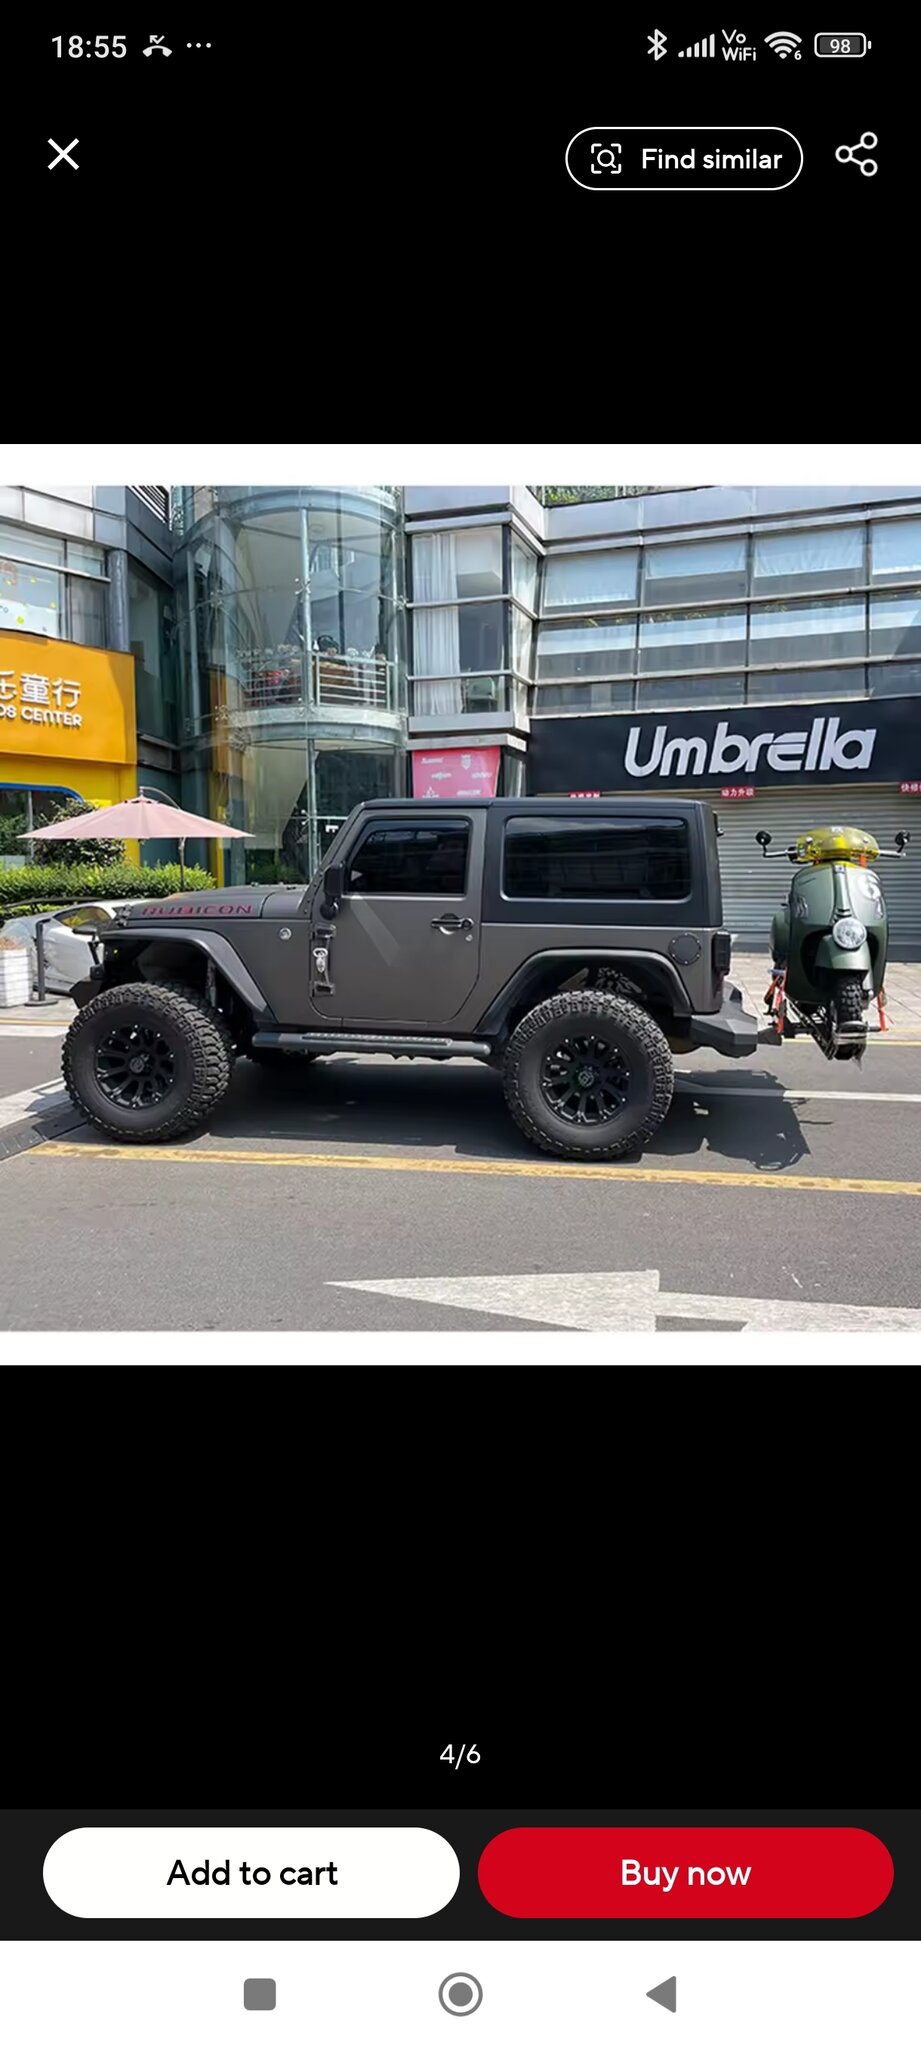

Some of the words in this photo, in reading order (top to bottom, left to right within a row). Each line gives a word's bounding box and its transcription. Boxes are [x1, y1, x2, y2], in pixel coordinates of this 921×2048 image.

[21, 705, 82, 728] CENTER
[623, 716, 877, 778] Umbrella
[141, 904, 254, 917] RUBICON
